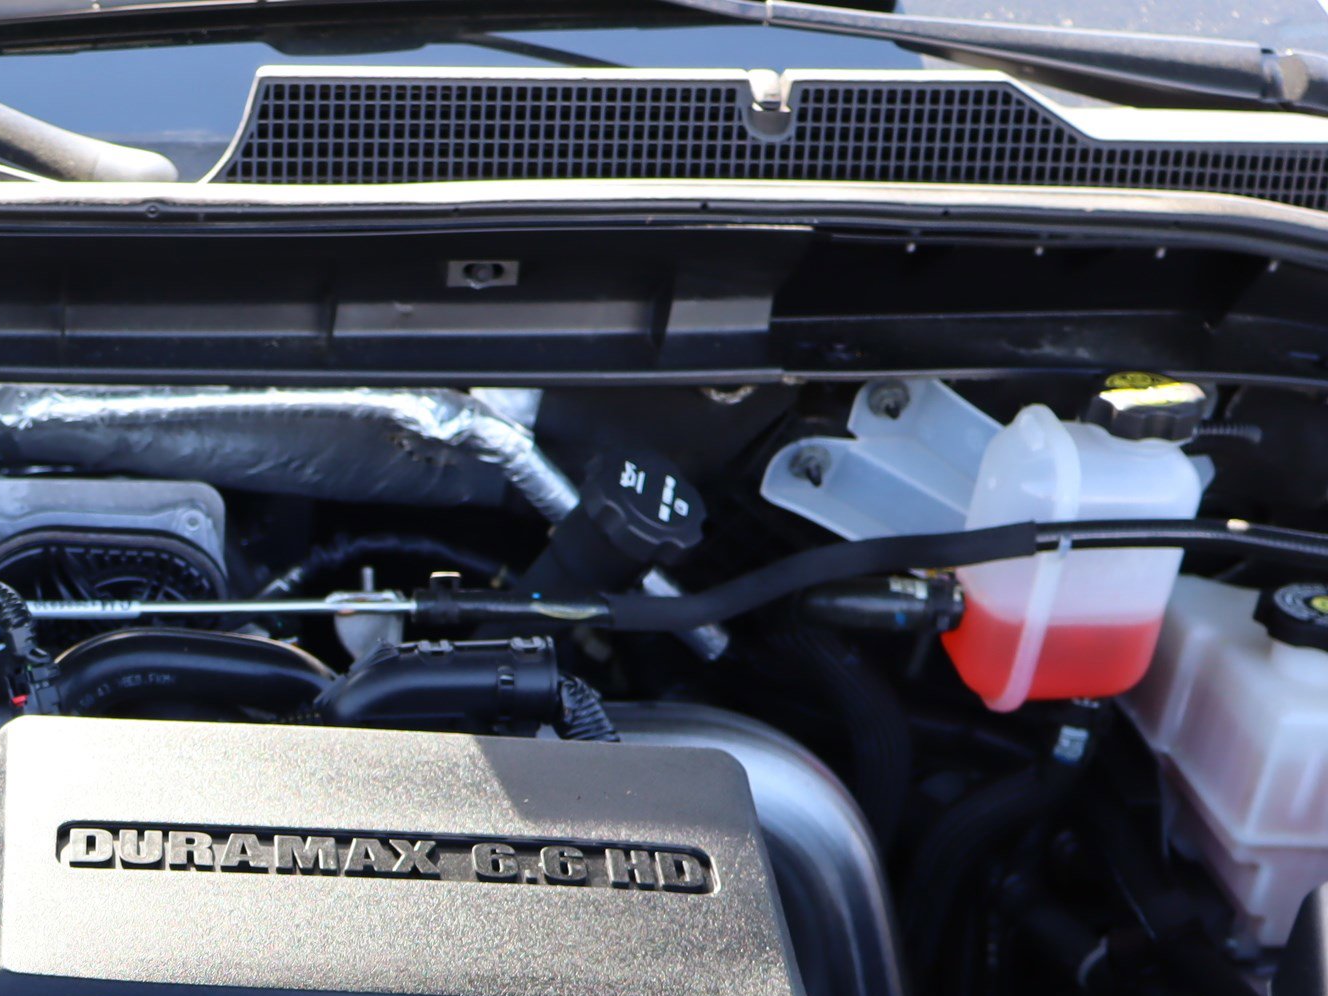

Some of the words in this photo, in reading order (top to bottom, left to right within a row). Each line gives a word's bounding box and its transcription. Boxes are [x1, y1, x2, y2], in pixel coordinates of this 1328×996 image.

[68, 827, 440, 879] DURAMAX
[472, 842, 588, 886] 6.6
[605, 848, 706, 893] HD
